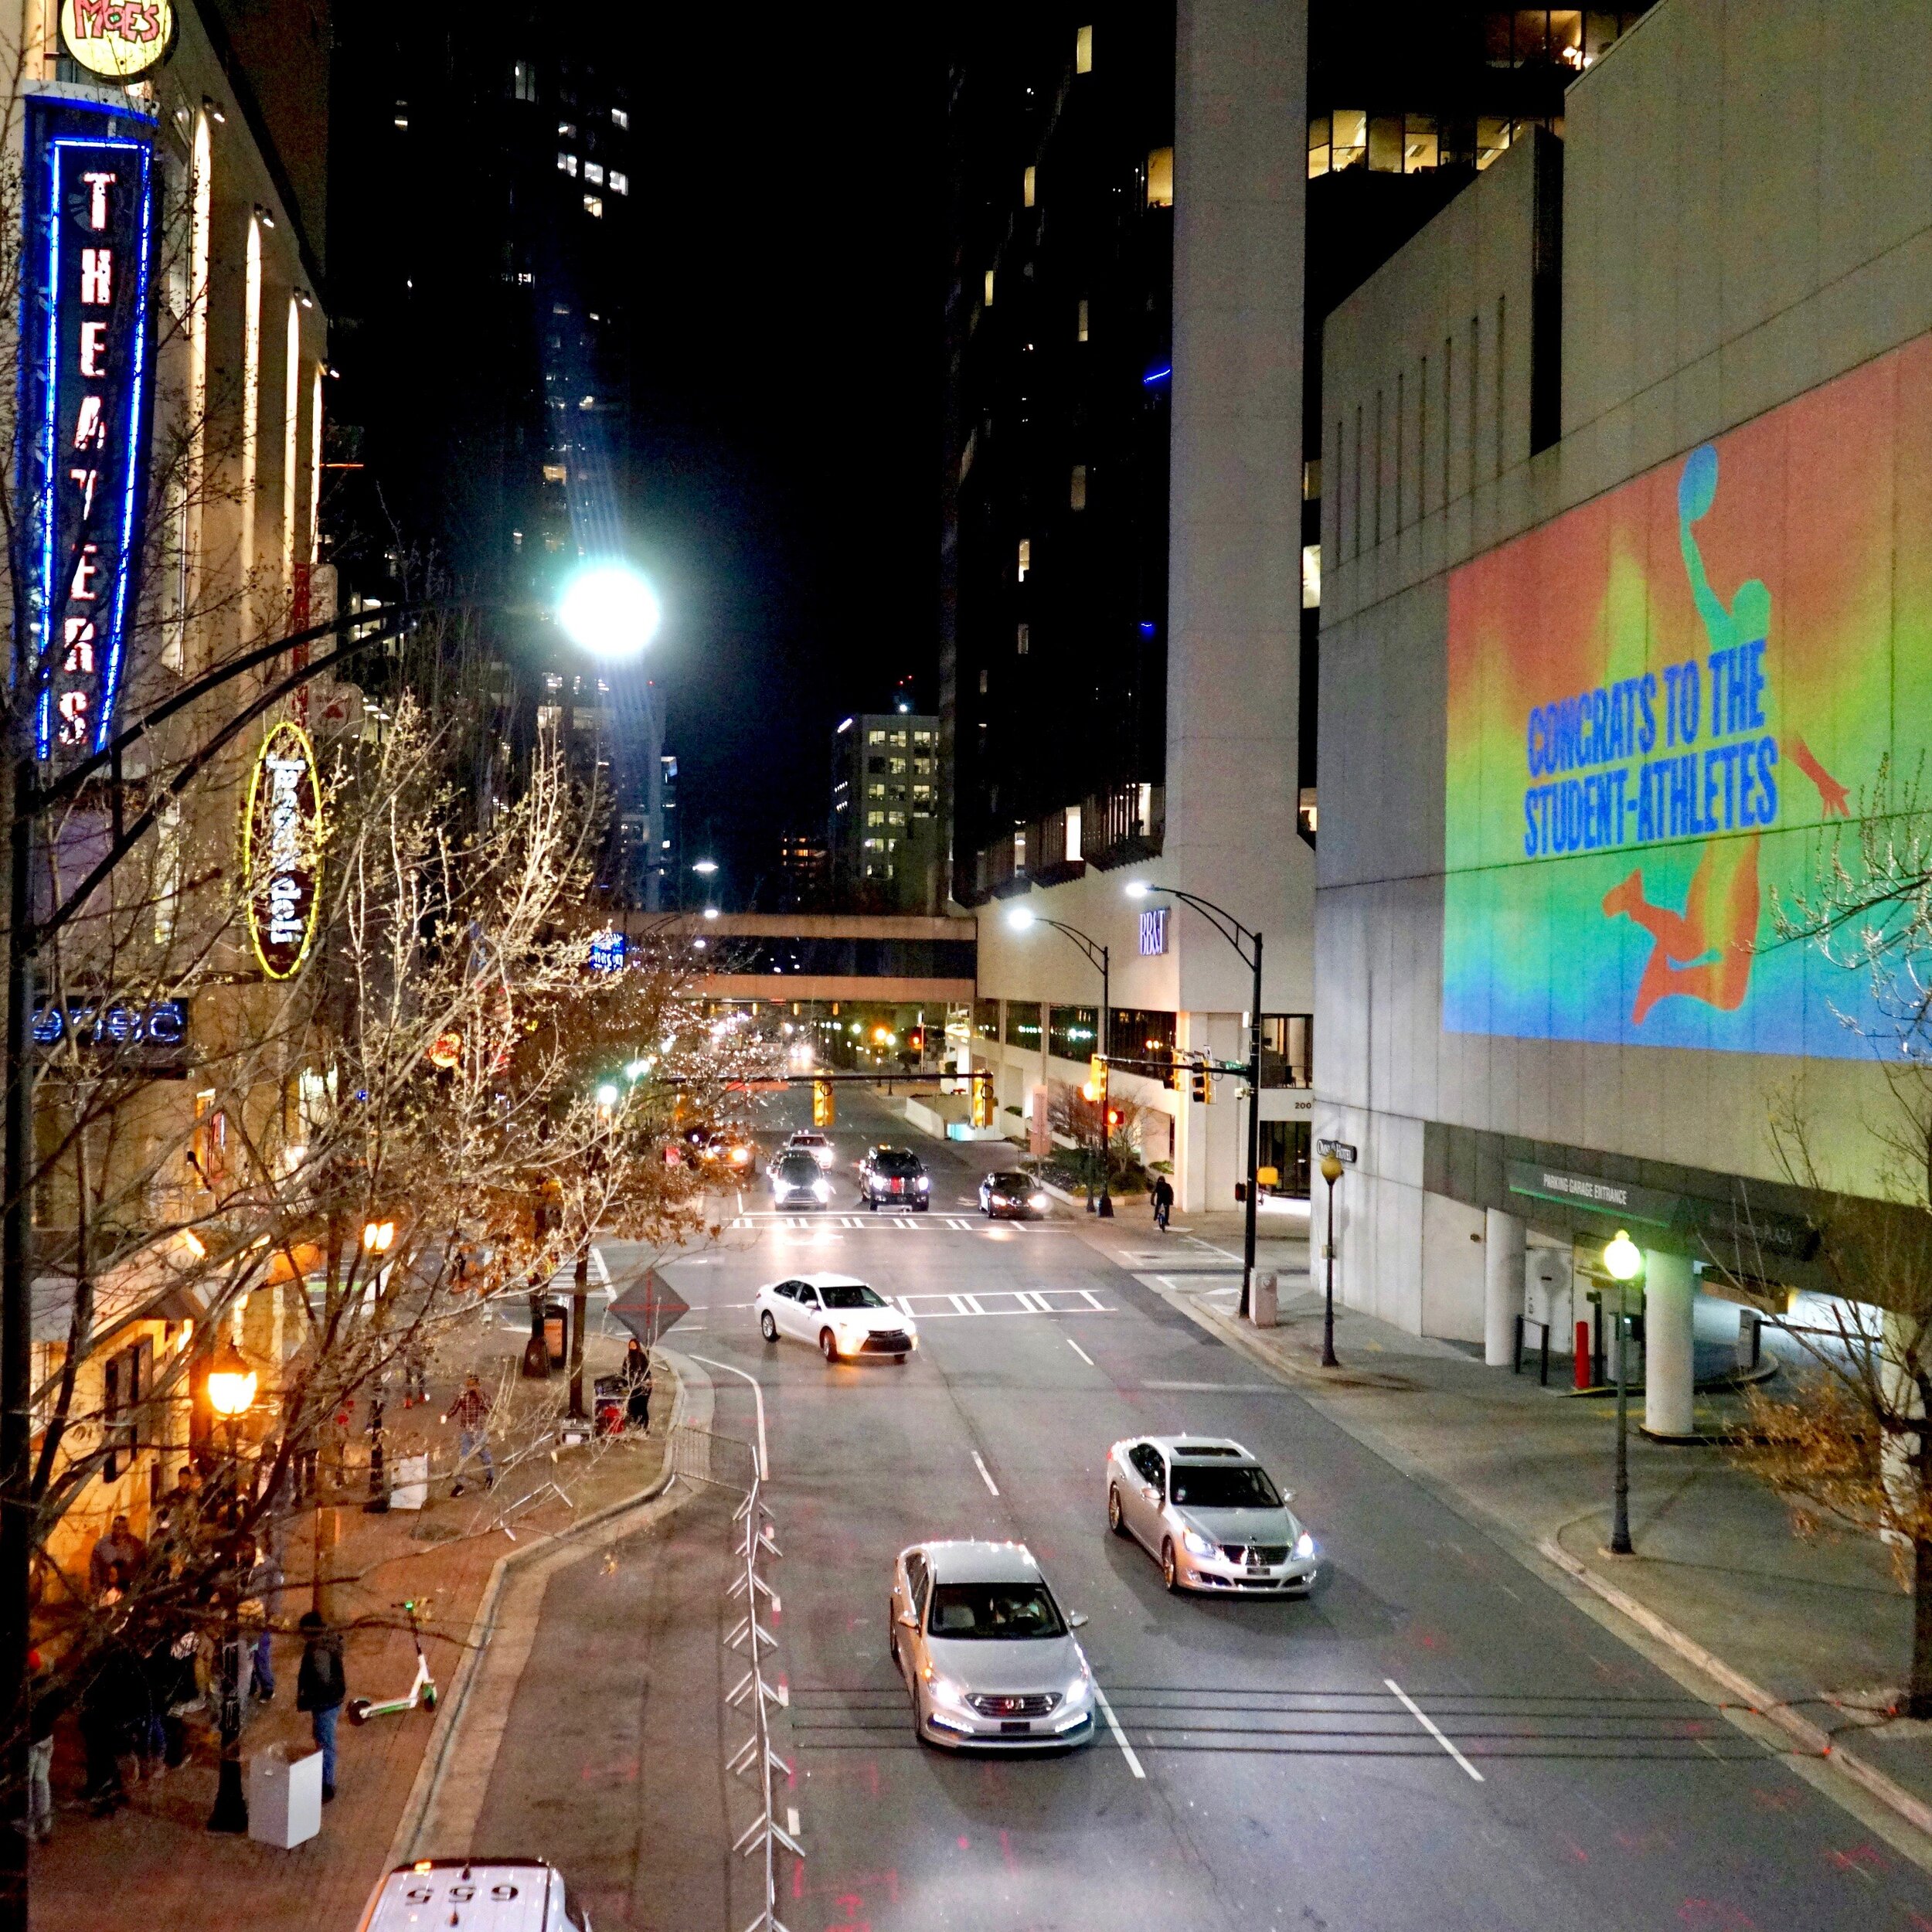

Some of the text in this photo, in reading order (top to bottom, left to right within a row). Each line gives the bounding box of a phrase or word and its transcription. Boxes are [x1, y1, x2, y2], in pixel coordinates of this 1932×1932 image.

[1527, 638, 1767, 779] CONGRATS TO THE
[1524, 736, 1778, 859] STUDENT-ATHLETES
[1139, 910, 1165, 955] BB&T
[1544, 1174, 1627, 1205] PARKING GARAGE ENTRANCE
